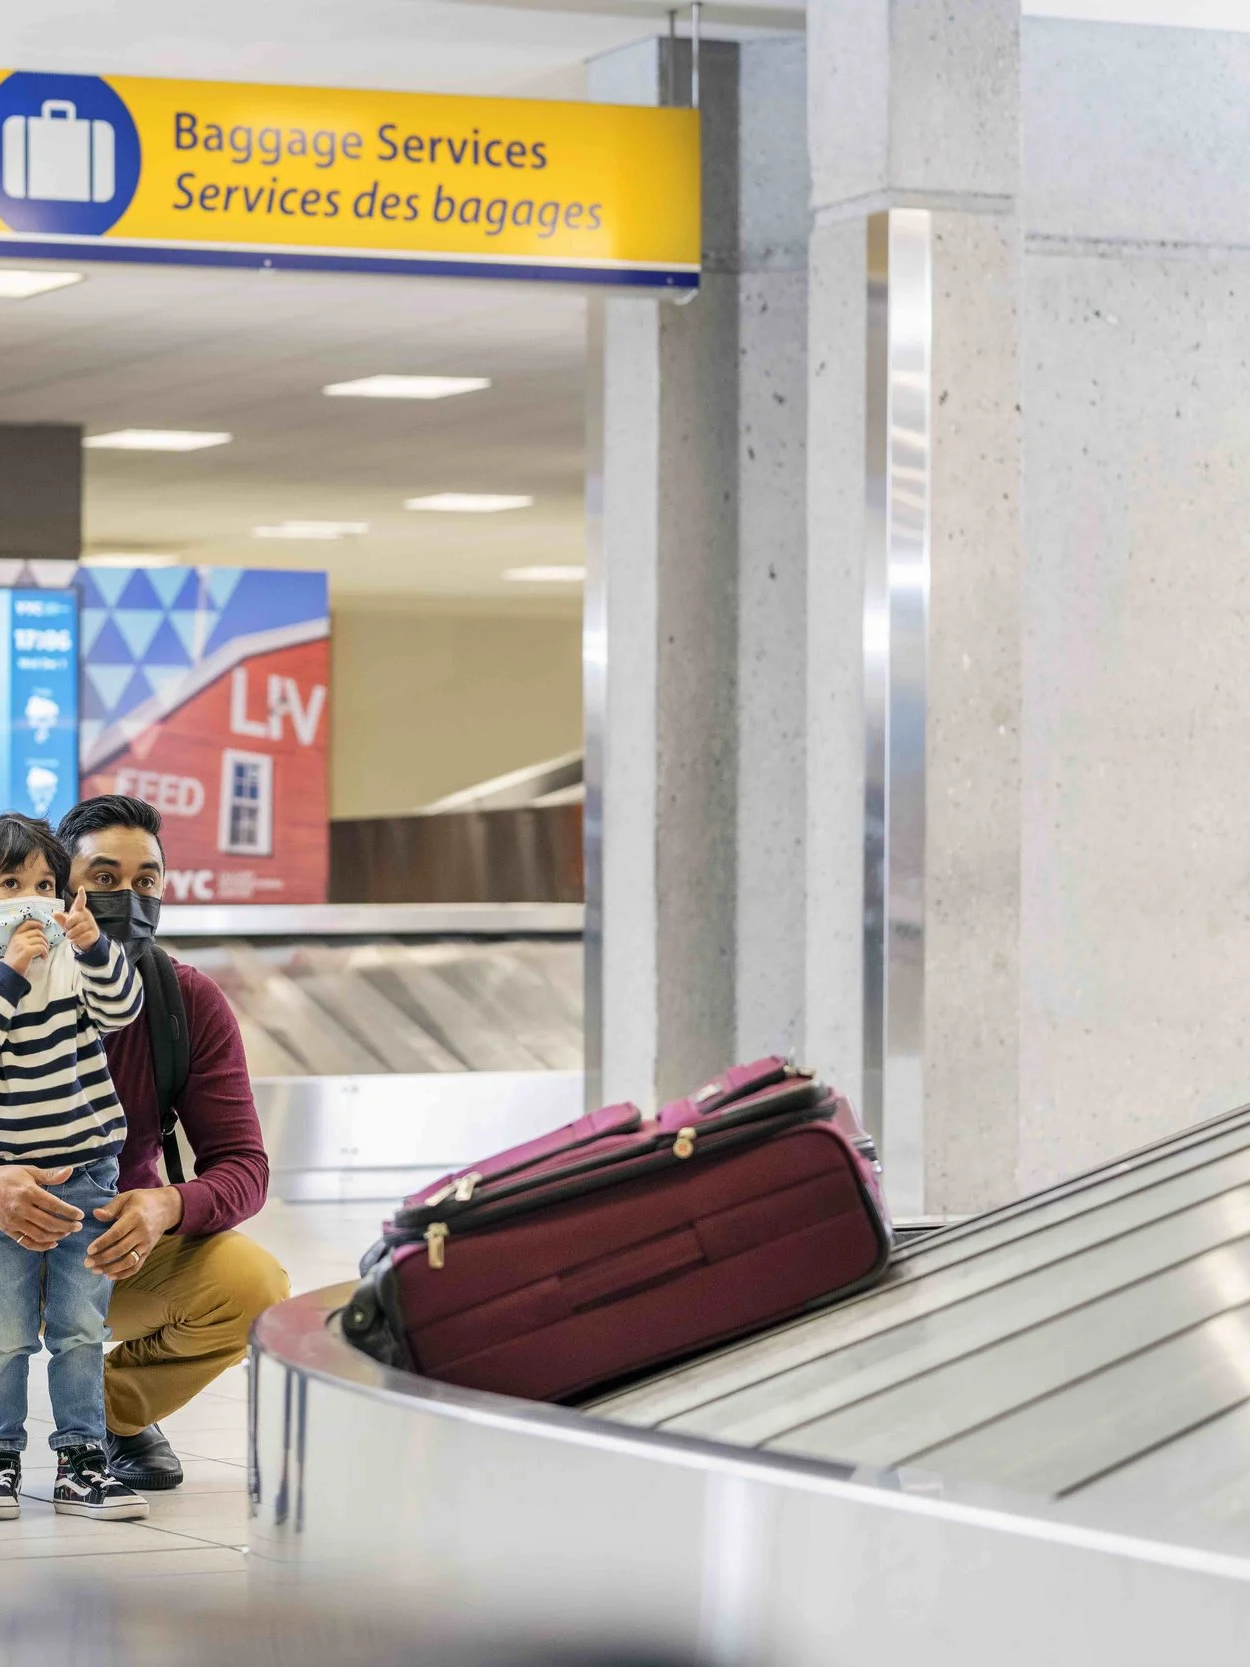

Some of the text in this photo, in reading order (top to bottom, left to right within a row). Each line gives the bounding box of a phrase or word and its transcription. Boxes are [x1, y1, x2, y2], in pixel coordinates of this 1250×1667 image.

[174, 112, 548, 169] Baggage Services
[173, 172, 603, 238] Services des bagages
[116, 768, 205, 816] FEED
